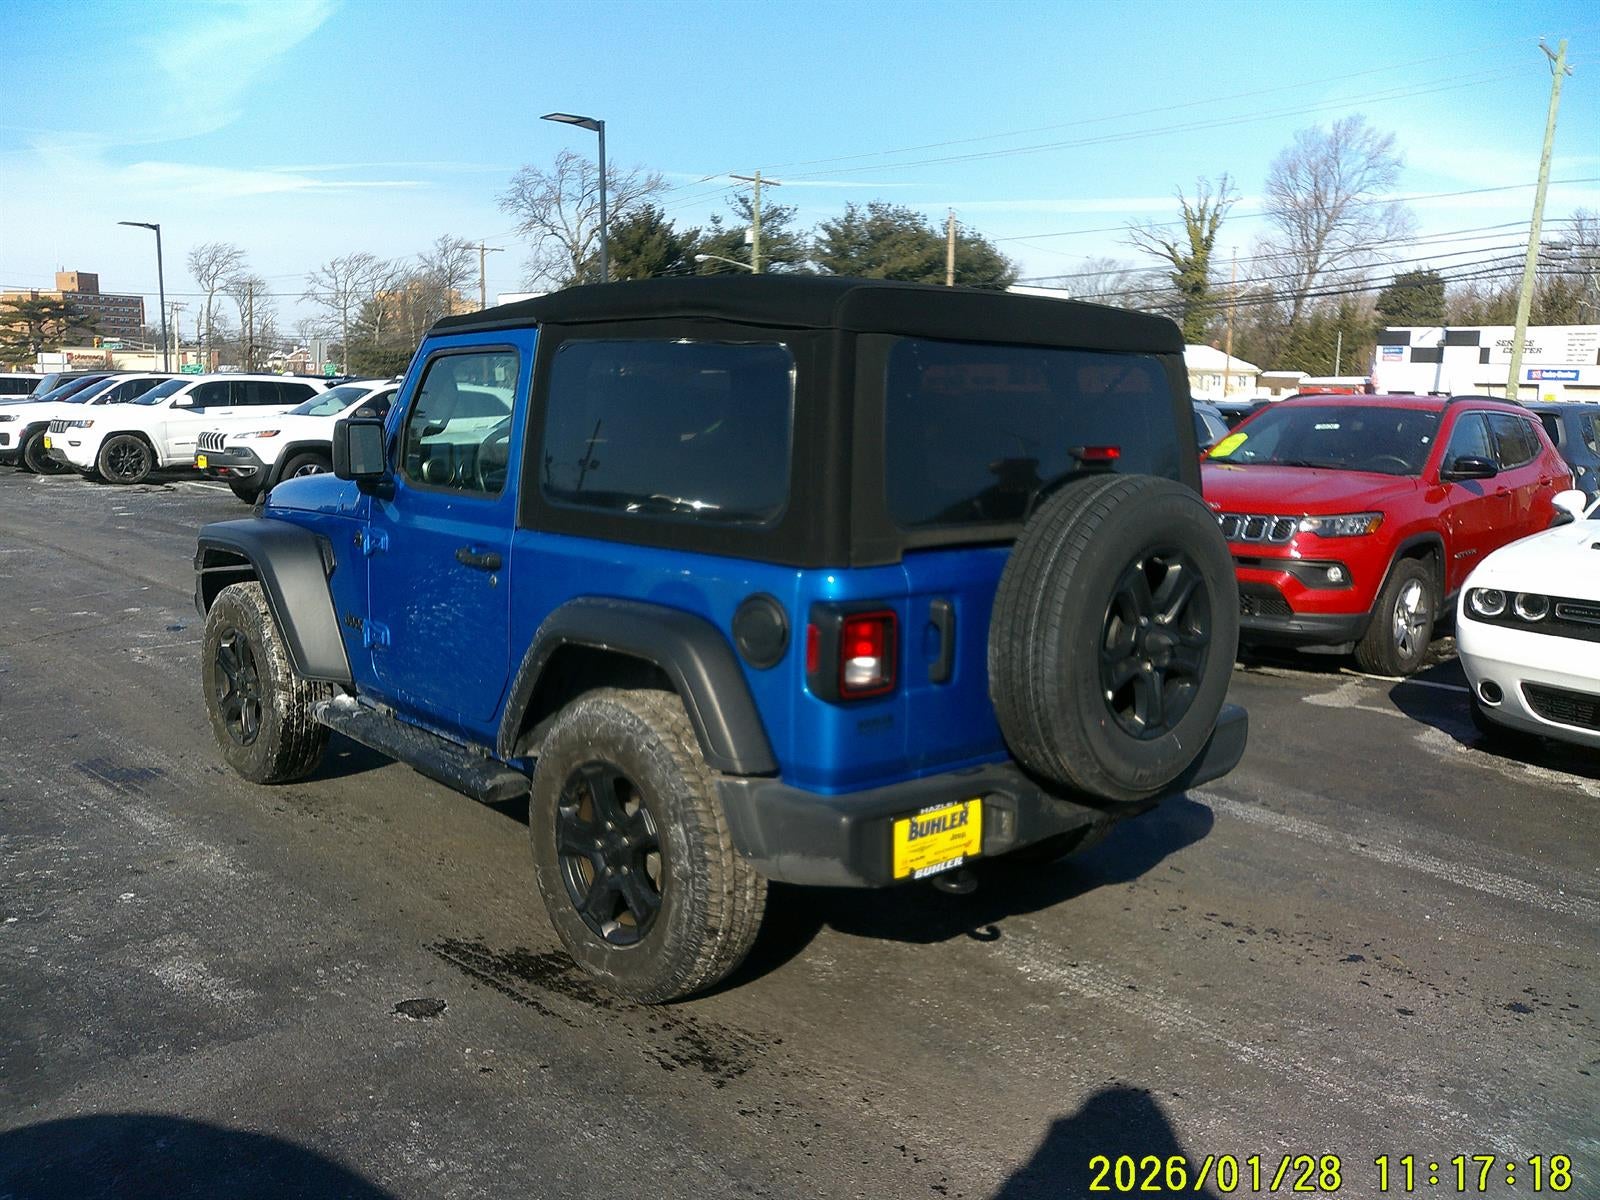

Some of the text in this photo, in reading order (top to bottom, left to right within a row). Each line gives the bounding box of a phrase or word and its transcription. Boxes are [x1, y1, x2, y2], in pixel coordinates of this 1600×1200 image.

[1495, 339, 1535, 347] SERCE
[908, 810, 968, 842] BUHLER
[914, 856, 963, 879] BUHLER
